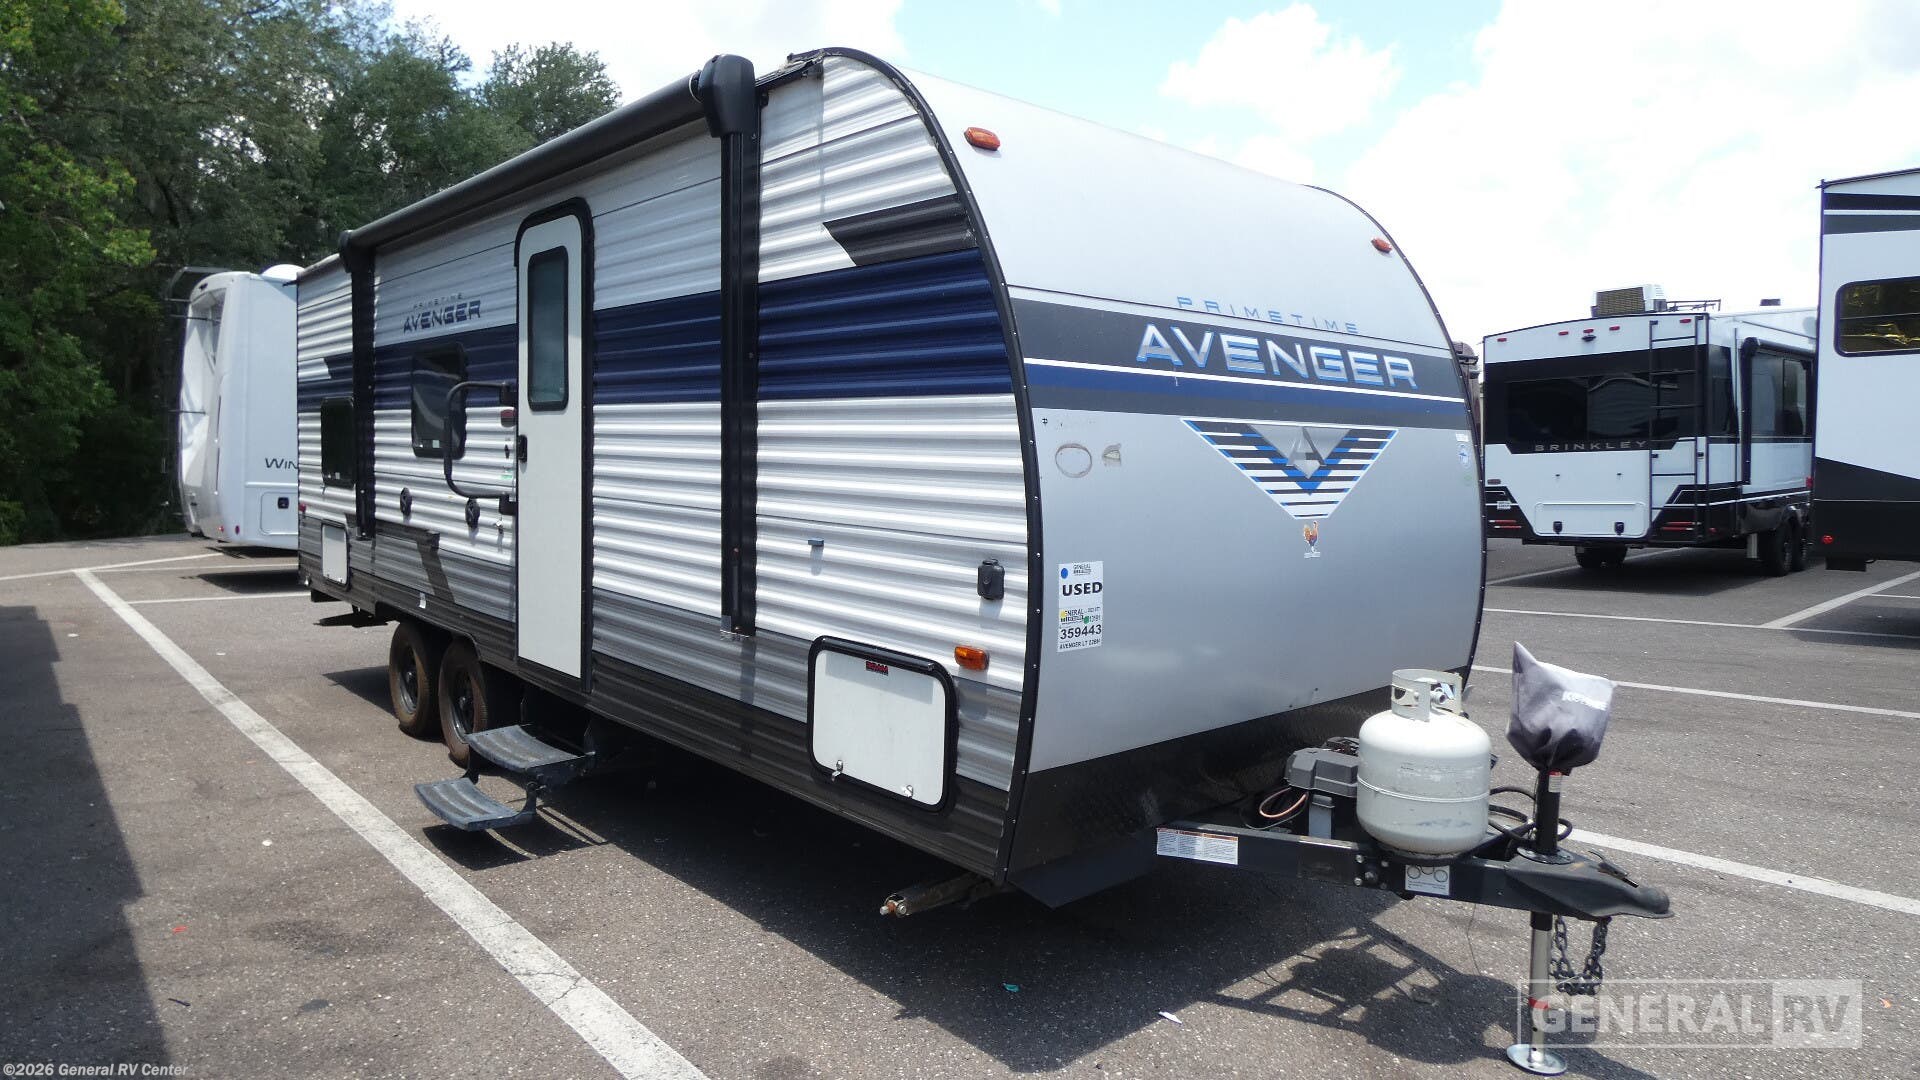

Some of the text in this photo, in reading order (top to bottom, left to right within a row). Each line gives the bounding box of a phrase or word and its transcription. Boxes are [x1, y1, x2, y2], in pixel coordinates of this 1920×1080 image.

[403, 300, 480, 335] AVENGER
[1176, 296, 1359, 334] PRIMETIME
[1136, 323, 1418, 389] AVENGER
[1534, 440, 1647, 452] BRINKLEY
[1062, 581, 1102, 597] USED
[1060, 624, 1102, 640] 359443
